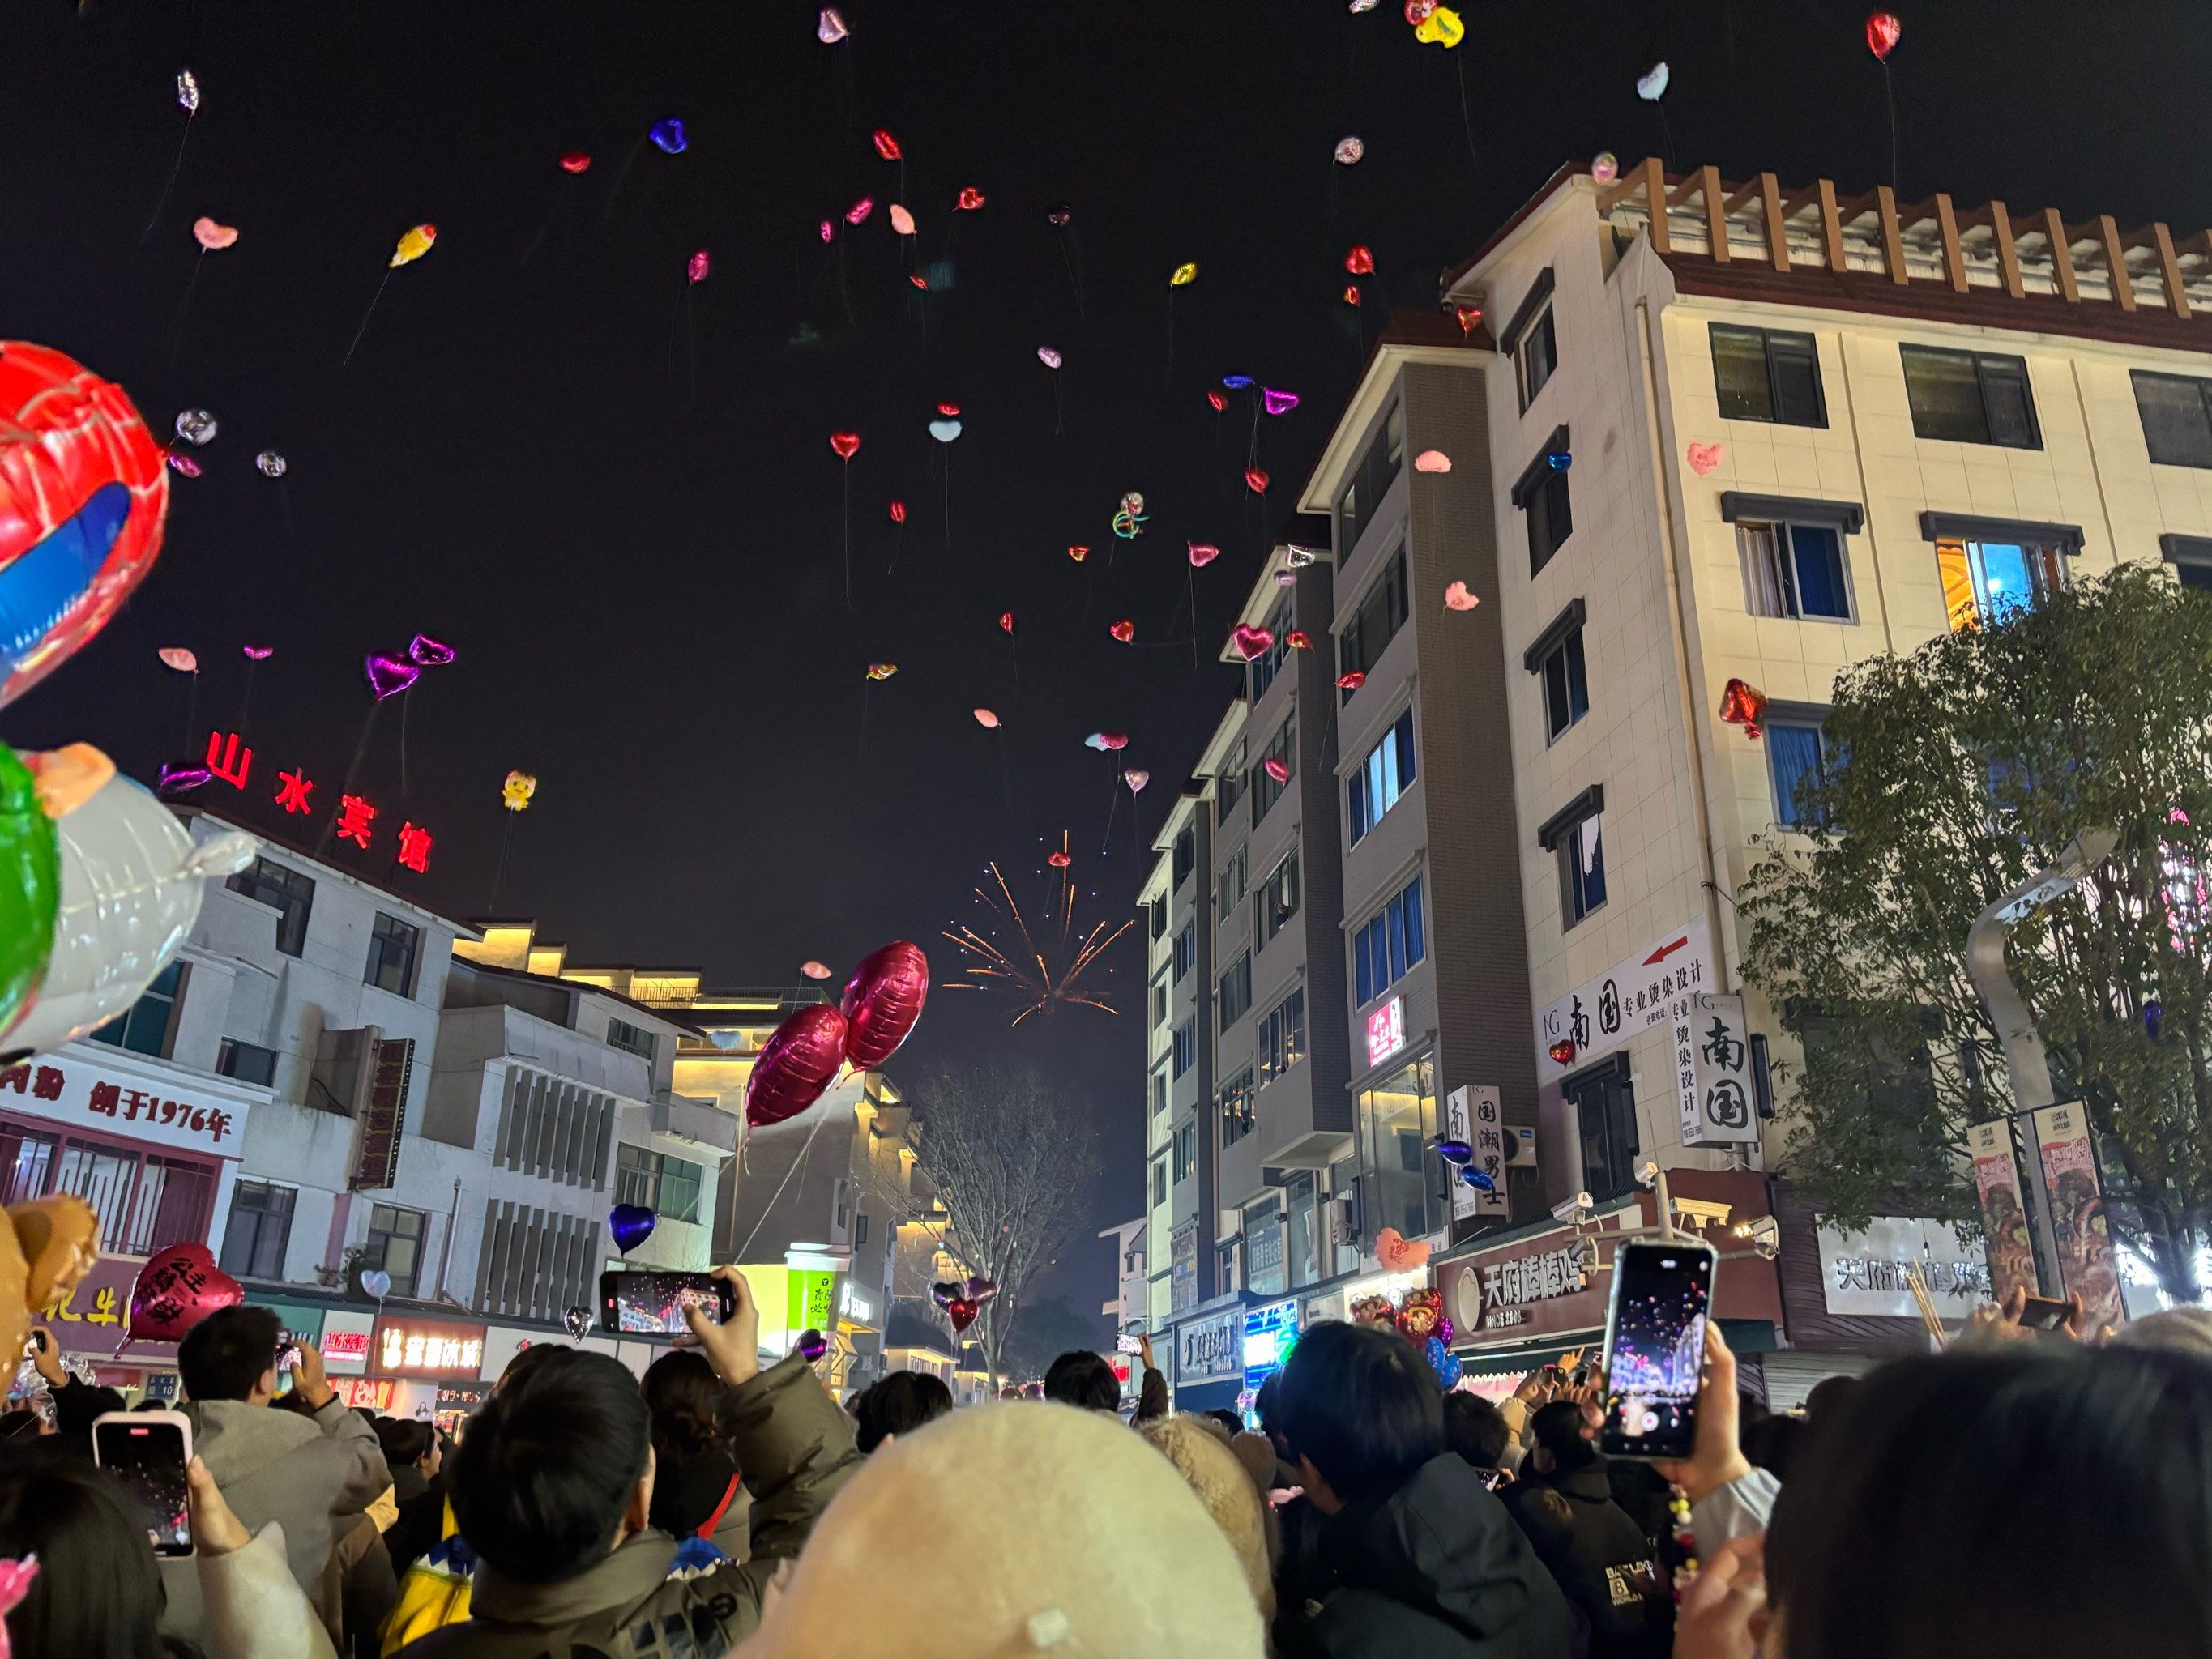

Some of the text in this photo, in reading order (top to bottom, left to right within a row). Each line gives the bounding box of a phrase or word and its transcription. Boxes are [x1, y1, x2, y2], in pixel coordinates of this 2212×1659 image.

[207, 731, 433, 874] 山水宾馆
[1569, 979, 1621, 1051] 南国
[1622, 959, 1702, 1017] 专业烫染设计
[1702, 1016, 1749, 1129] 南国
[89, 1081, 233, 1143] 创于1976年
[1484, 1247, 1581, 1309] 天府棒棒鸡
